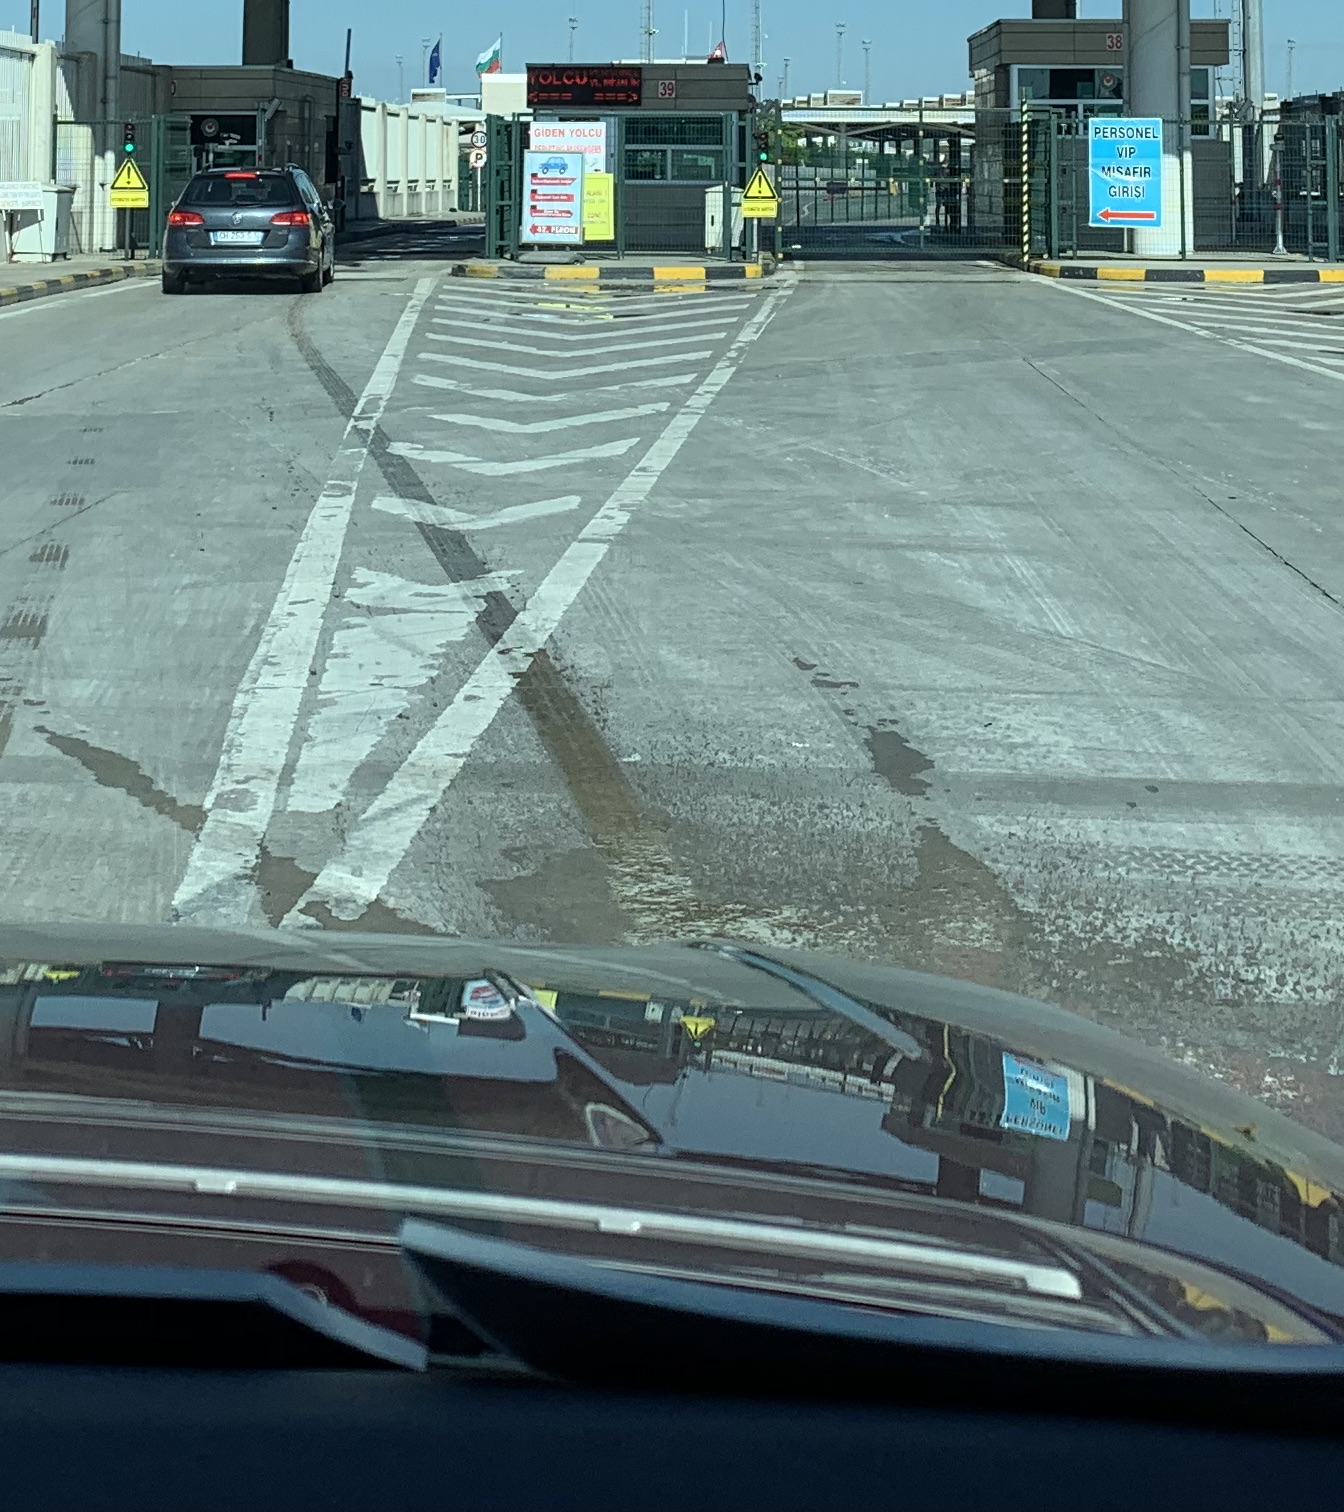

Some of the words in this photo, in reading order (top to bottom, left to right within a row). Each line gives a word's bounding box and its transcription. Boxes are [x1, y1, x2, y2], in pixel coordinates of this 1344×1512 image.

[1107, 34, 1123, 50] 38
[529, 70, 589, 86] YOLCU
[659, 81, 675, 97] 39
[534, 126, 565, 138] GİDEN
[569, 128, 603, 138] YOLCU
[1094, 126, 1159, 139] PERSONEL
